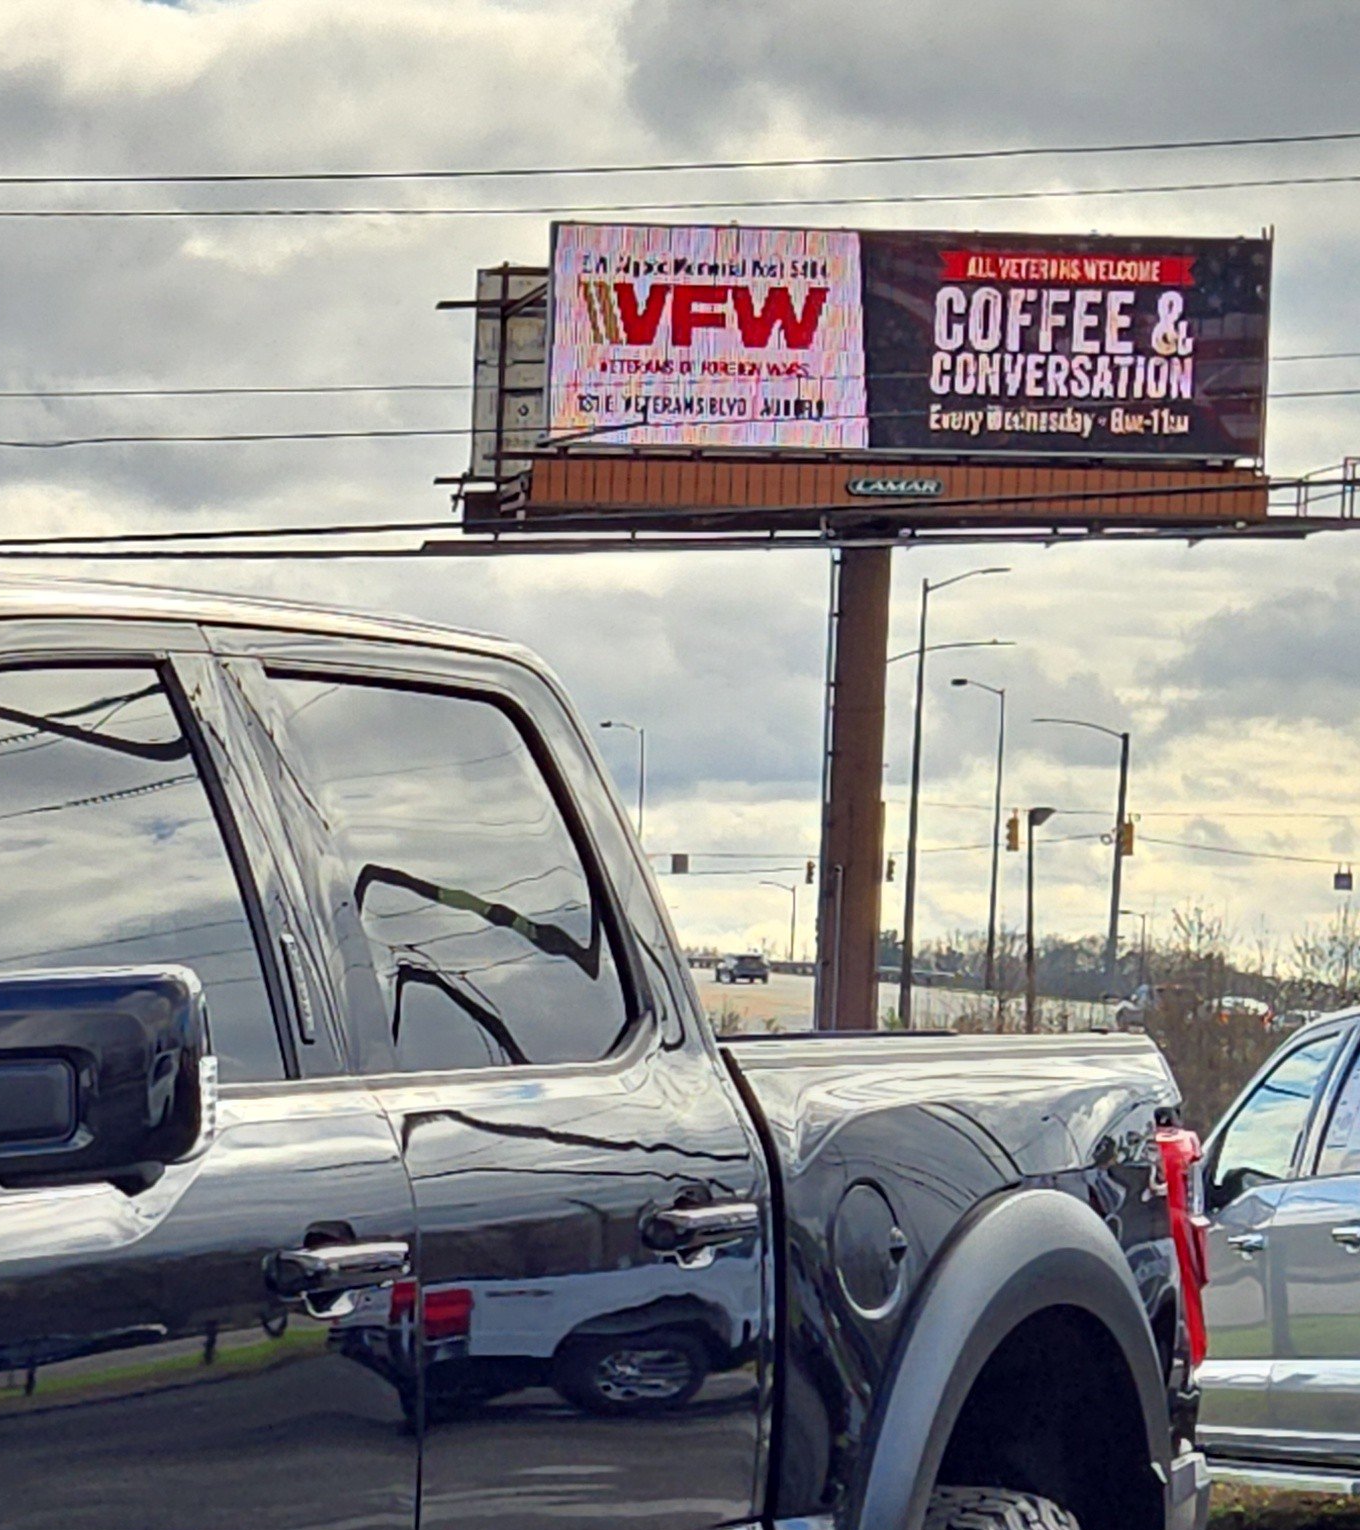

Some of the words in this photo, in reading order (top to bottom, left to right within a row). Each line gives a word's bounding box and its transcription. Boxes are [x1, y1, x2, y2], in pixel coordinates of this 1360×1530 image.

[966, 256, 997, 278] ALL
[998, 257, 1080, 281] VETERANS
[1082, 259, 1161, 283] WELCOME
[614, 282, 830, 350] VFW
[934, 286, 1135, 354] COFFEE
[1151, 290, 1194, 356] &
[929, 351, 1193, 399] CONVERSATION
[709, 397, 746, 416] BLVD
[929, 404, 984, 435] Every
[986, 404, 1097, 438] Wednesday
[856, 480, 938, 493] LAMAR
